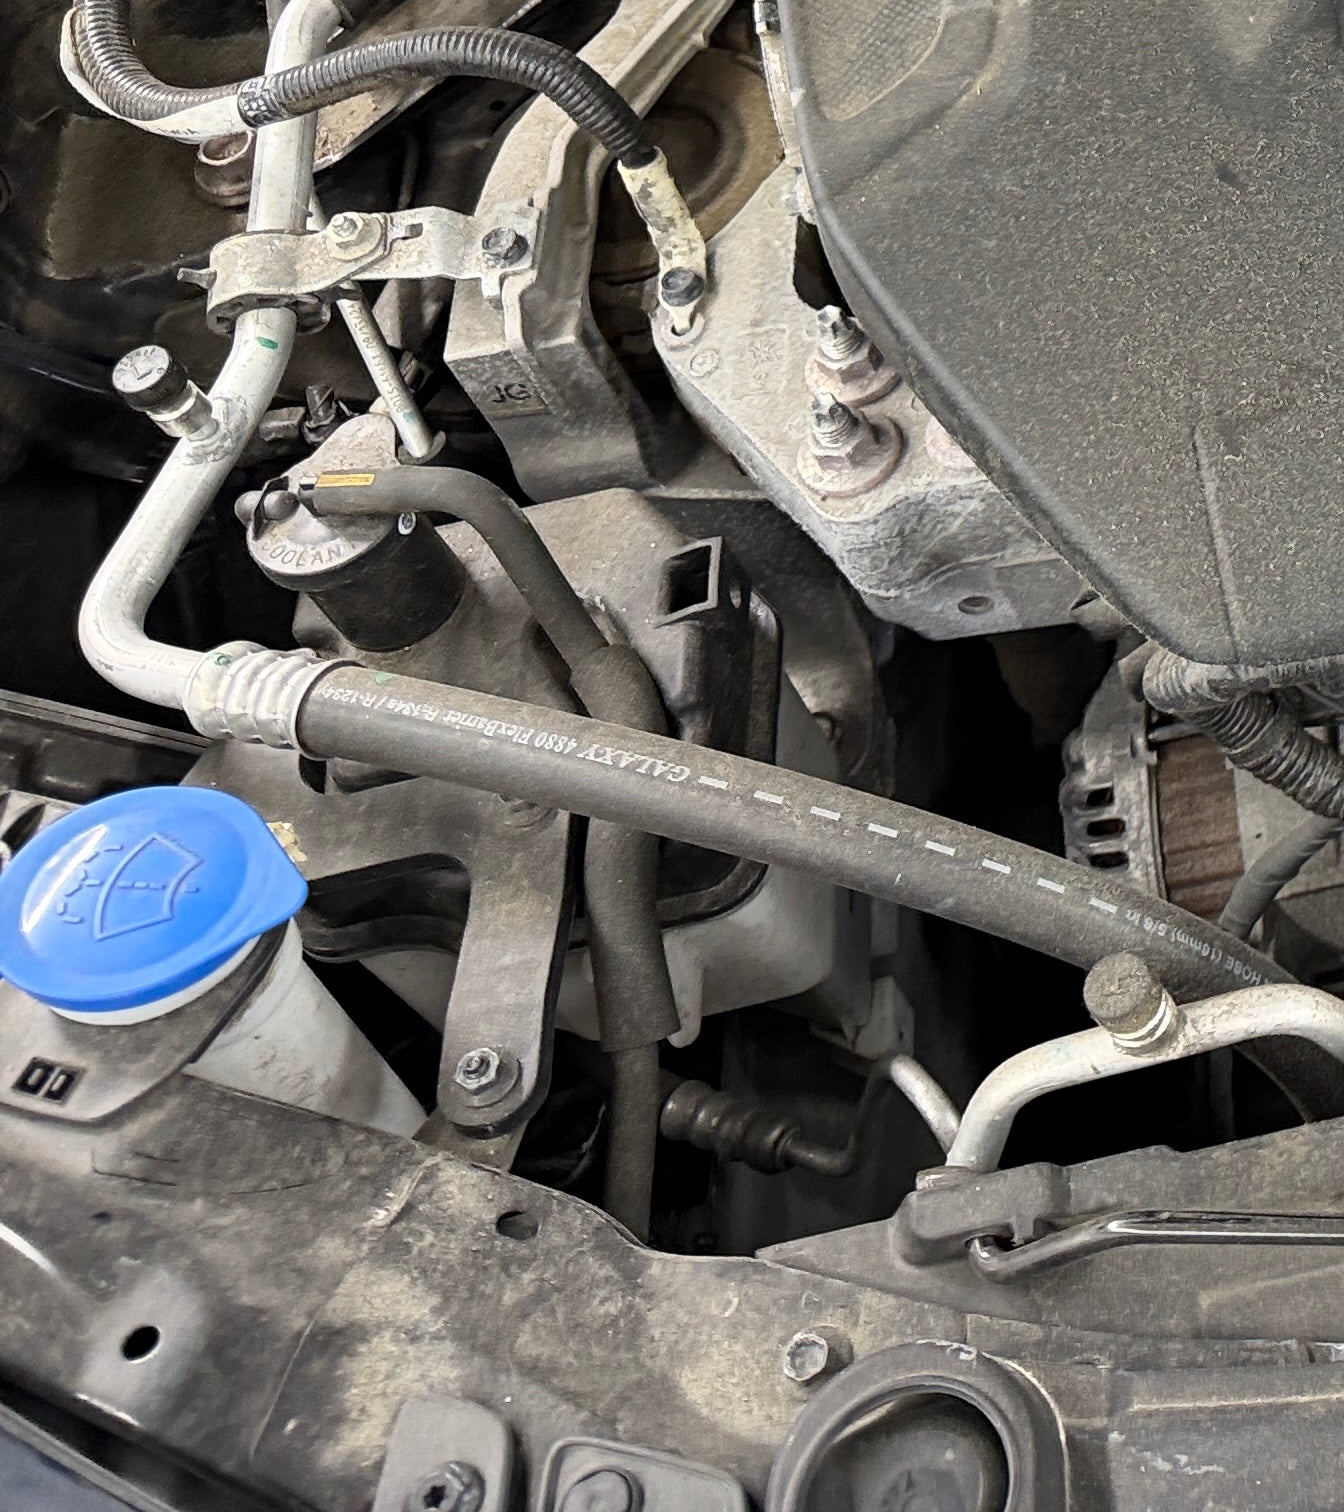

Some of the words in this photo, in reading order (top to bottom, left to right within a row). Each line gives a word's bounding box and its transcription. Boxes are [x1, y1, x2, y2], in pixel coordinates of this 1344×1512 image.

[442, 709, 536, 745] FlexBarrier
[533, 730, 578, 755] 4880
[576, 743, 691, 783] GALAXY
